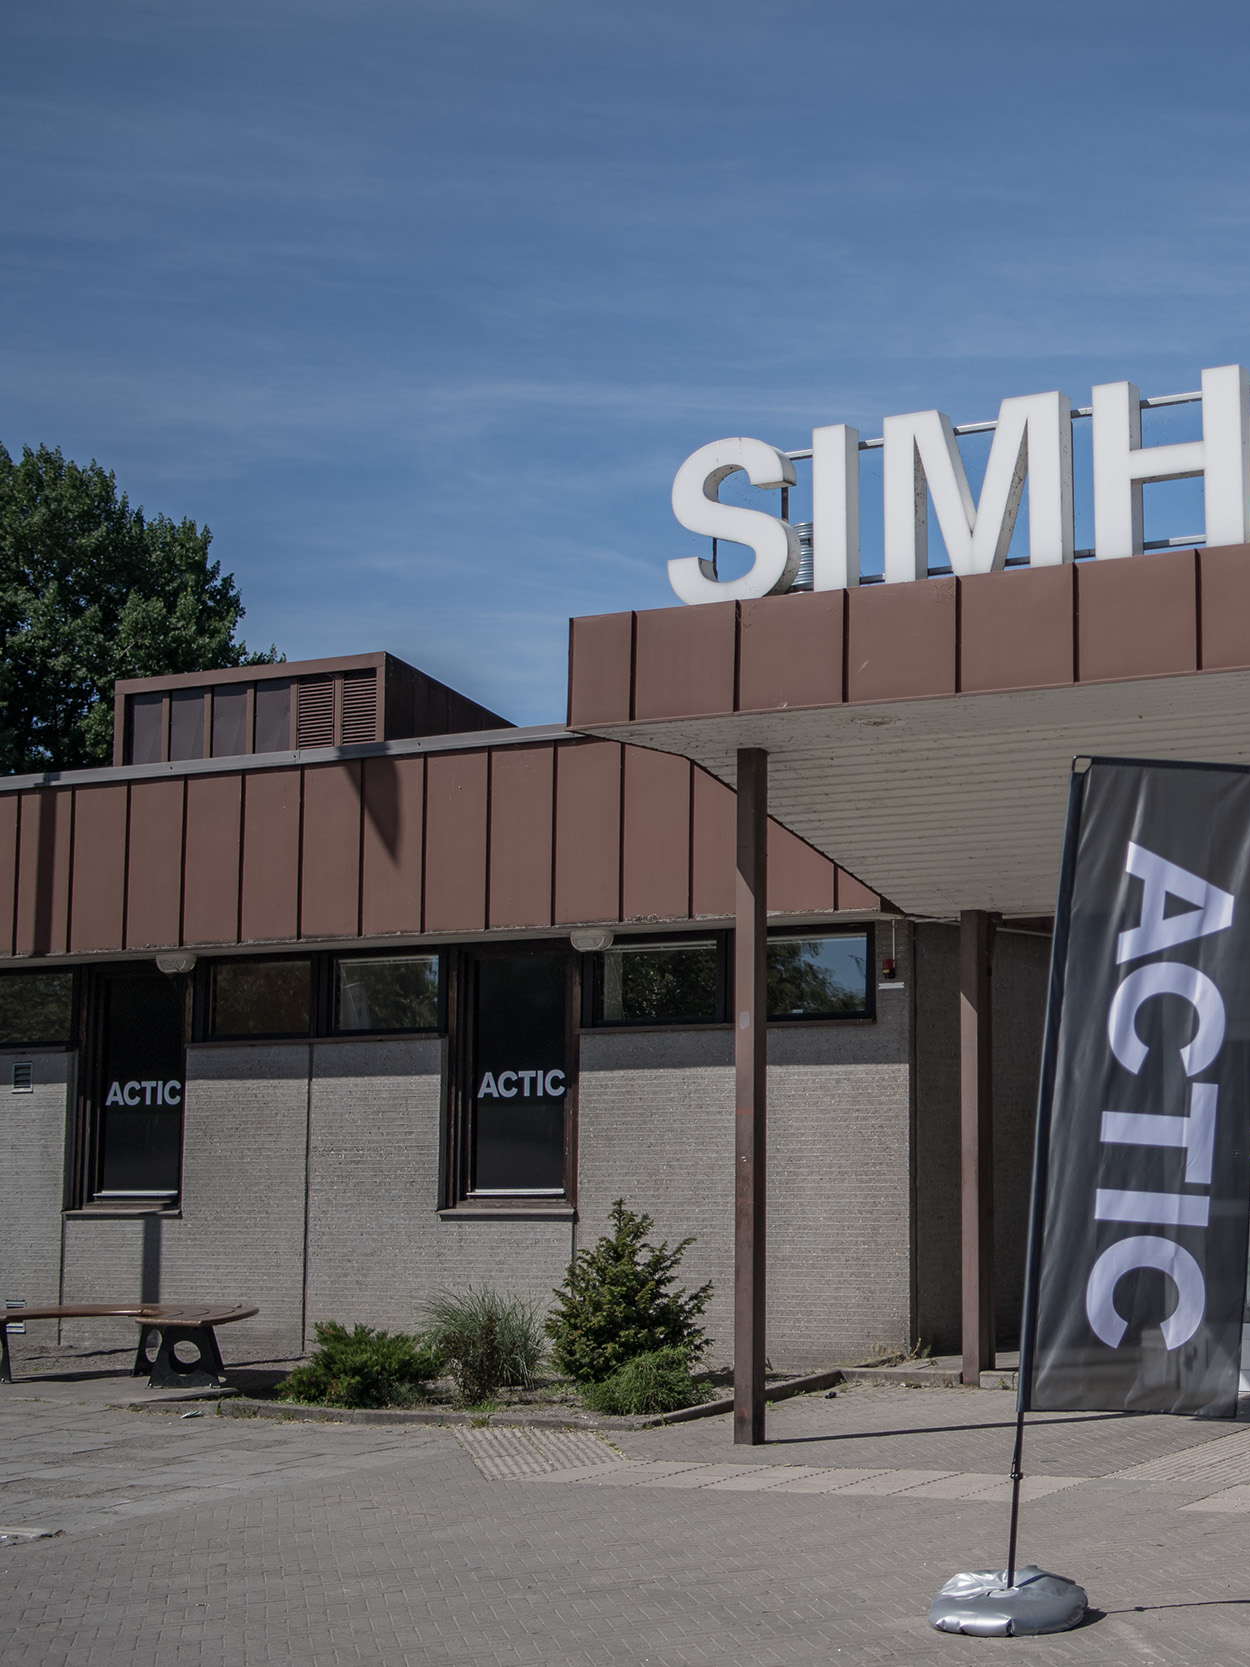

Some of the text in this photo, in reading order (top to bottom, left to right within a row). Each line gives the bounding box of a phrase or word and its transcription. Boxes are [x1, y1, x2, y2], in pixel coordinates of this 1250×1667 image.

[105, 1080, 182, 1107] ACTIC
[477, 1068, 566, 1099] ACTIC
[1085, 841, 1235, 1351] ACTIC
